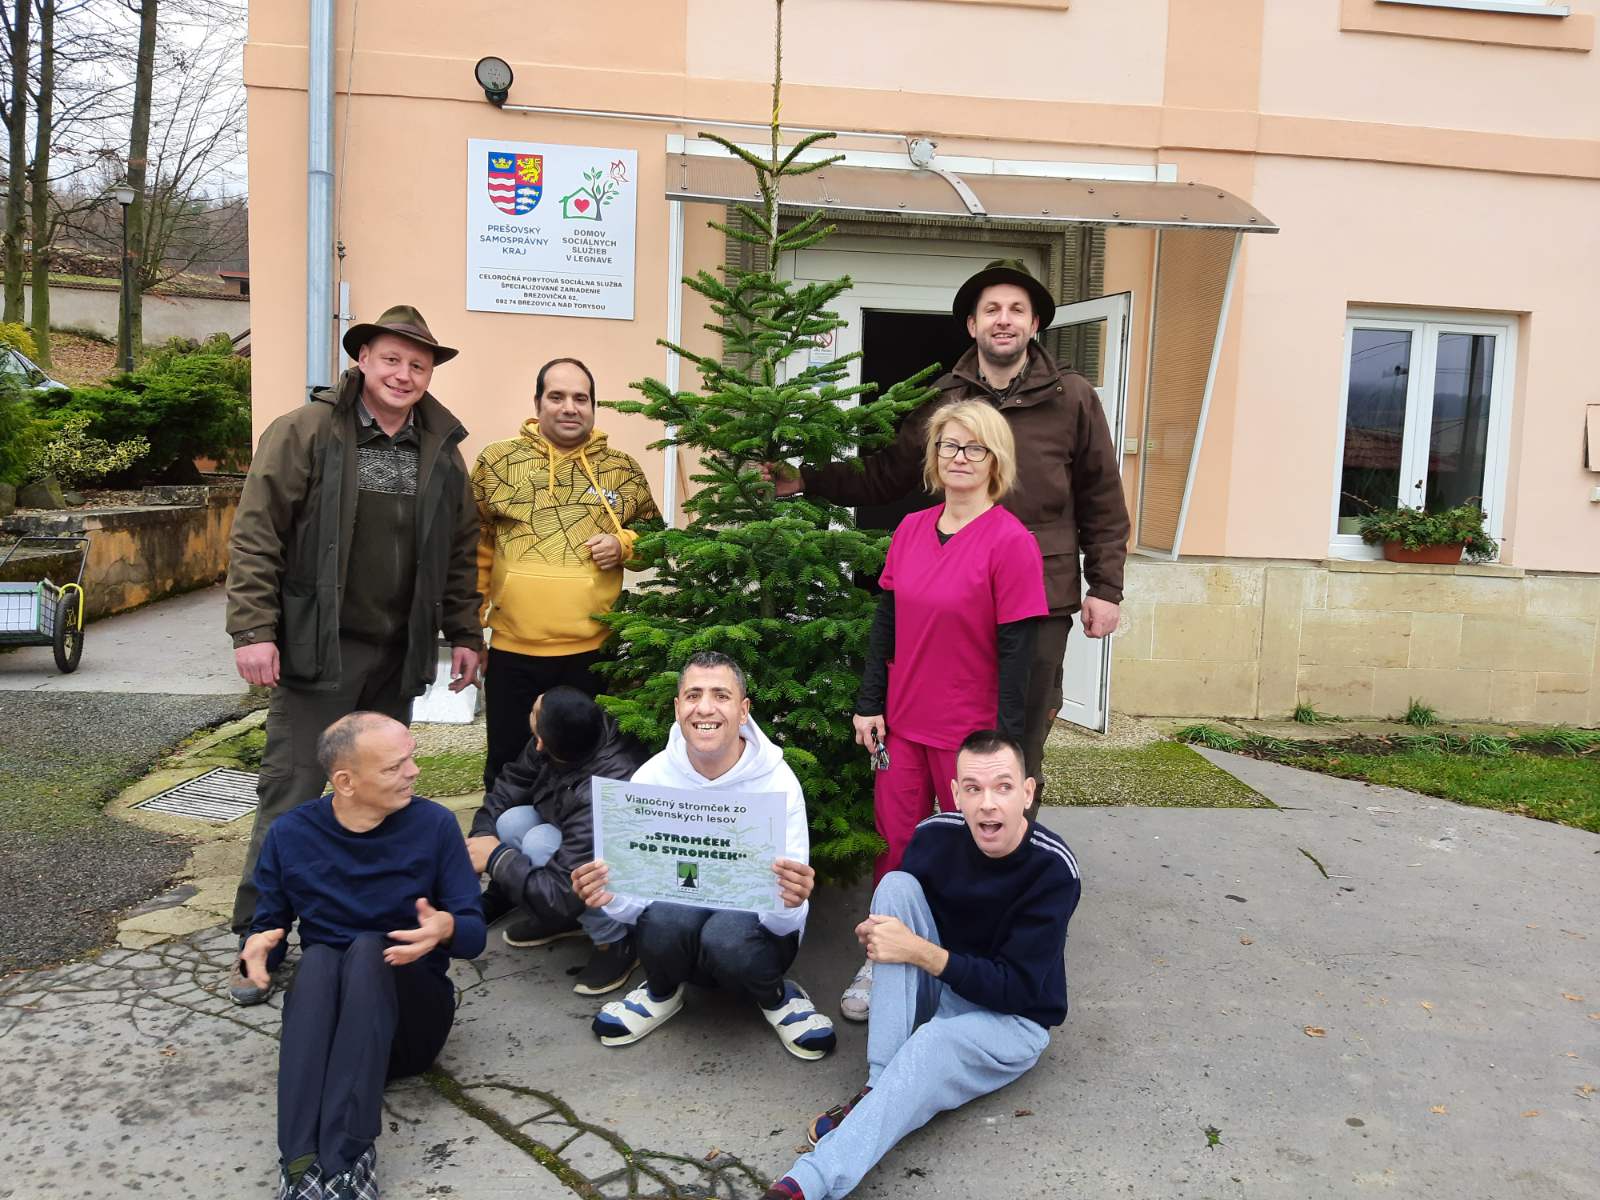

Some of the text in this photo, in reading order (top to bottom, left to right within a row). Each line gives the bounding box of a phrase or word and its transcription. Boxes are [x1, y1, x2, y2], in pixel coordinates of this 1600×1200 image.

[574, 229, 606, 238] DOMOV
[479, 235, 549, 246] SAMOSPRÁVNY
[562, 237, 617, 247] SOCIÁLNYCH
[502, 247, 527, 256] KRAJ
[572, 246, 607, 255] SLUŽIEB
[573, 255, 613, 264] LEGNAVE
[560, 286, 601, 295] ZARIADENIE
[517, 299, 556, 308] BREZOVICA
[573, 302, 606, 310] TORYSOU
[625, 793, 747, 814] Vianočný stromček zo
[634, 807, 737, 824] slovenských lesov
[629, 841, 658, 853] POD
